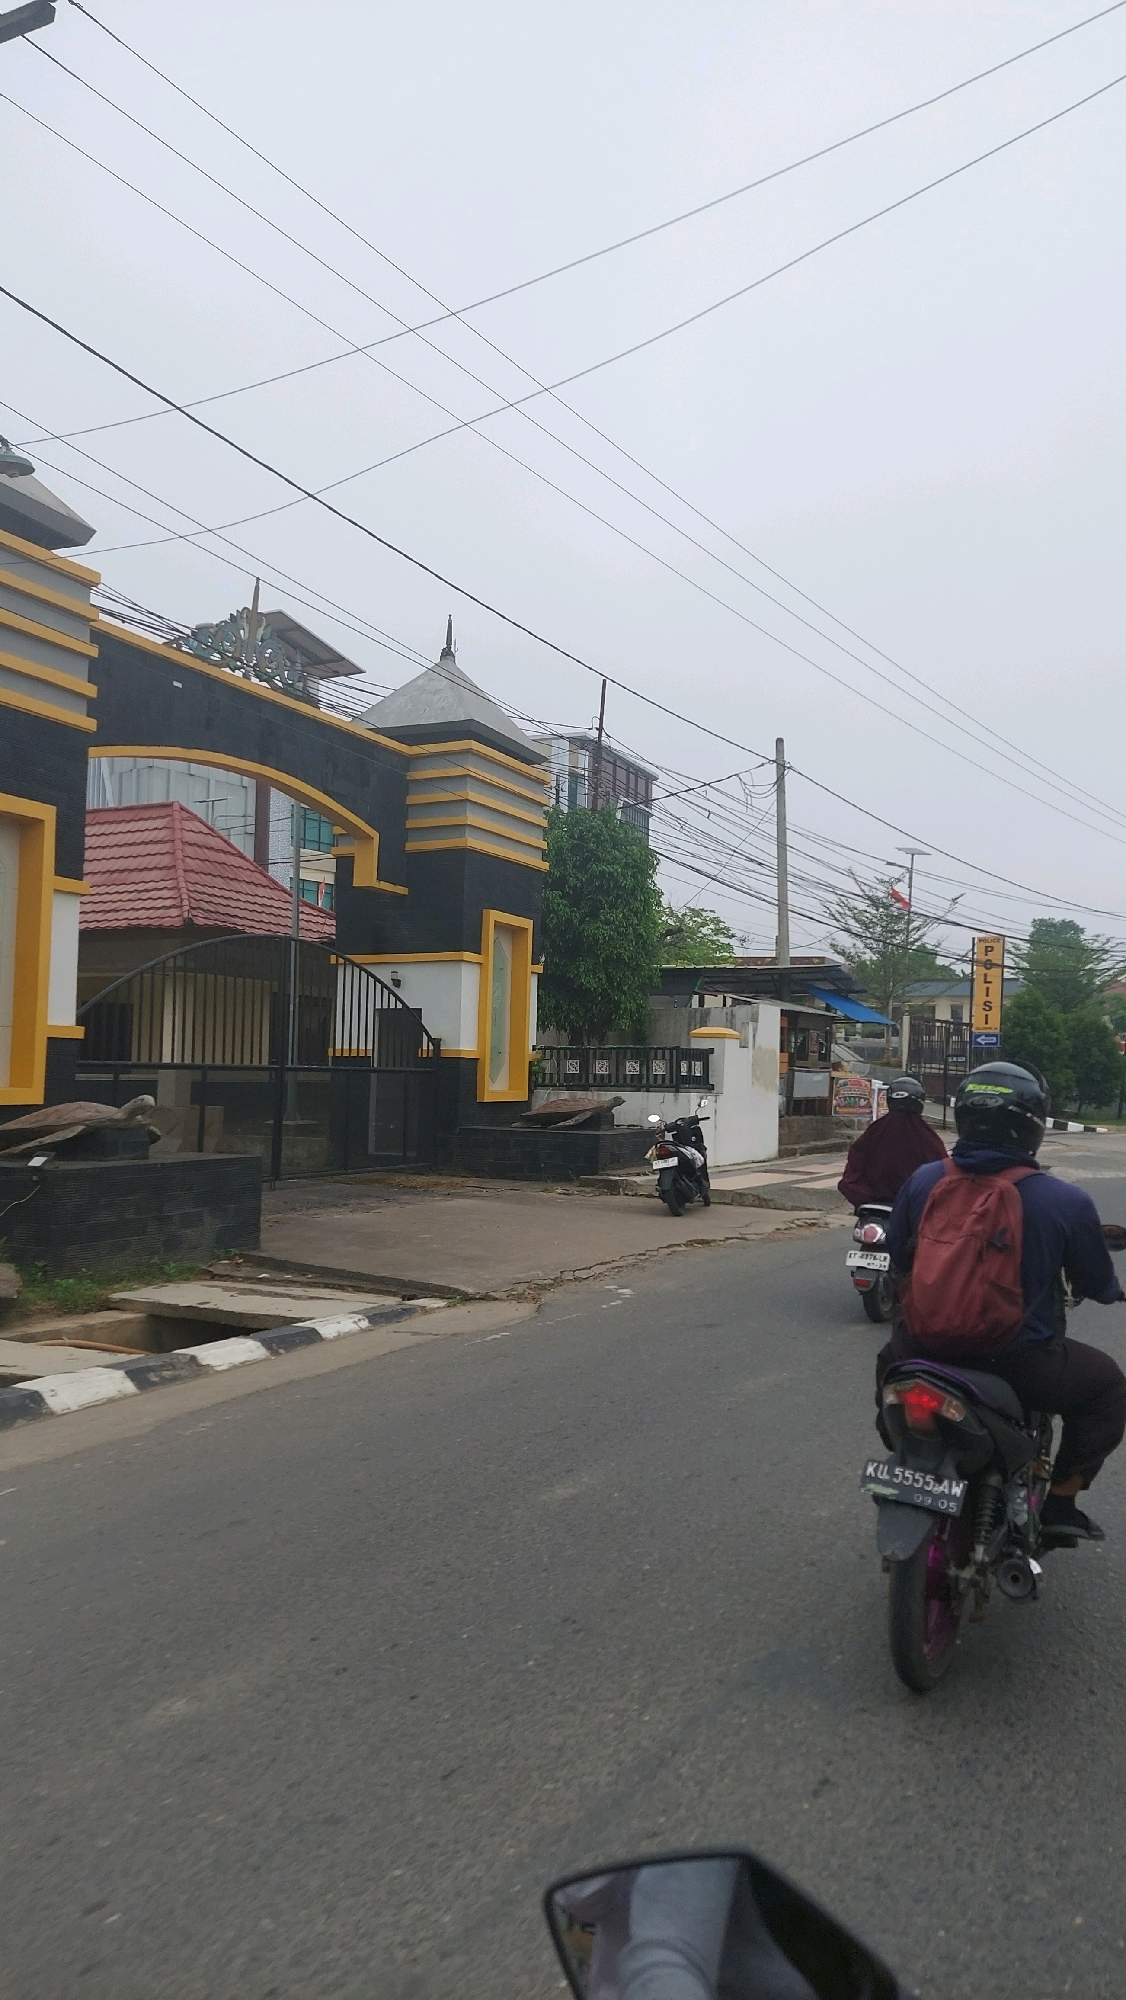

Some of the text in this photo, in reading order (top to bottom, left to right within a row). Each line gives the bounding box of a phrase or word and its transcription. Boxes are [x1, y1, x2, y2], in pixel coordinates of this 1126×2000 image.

[982, 945, 995, 1025] POLISI
[893, 1468, 935, 1491] 5555
[939, 1479, 966, 1498] AW
